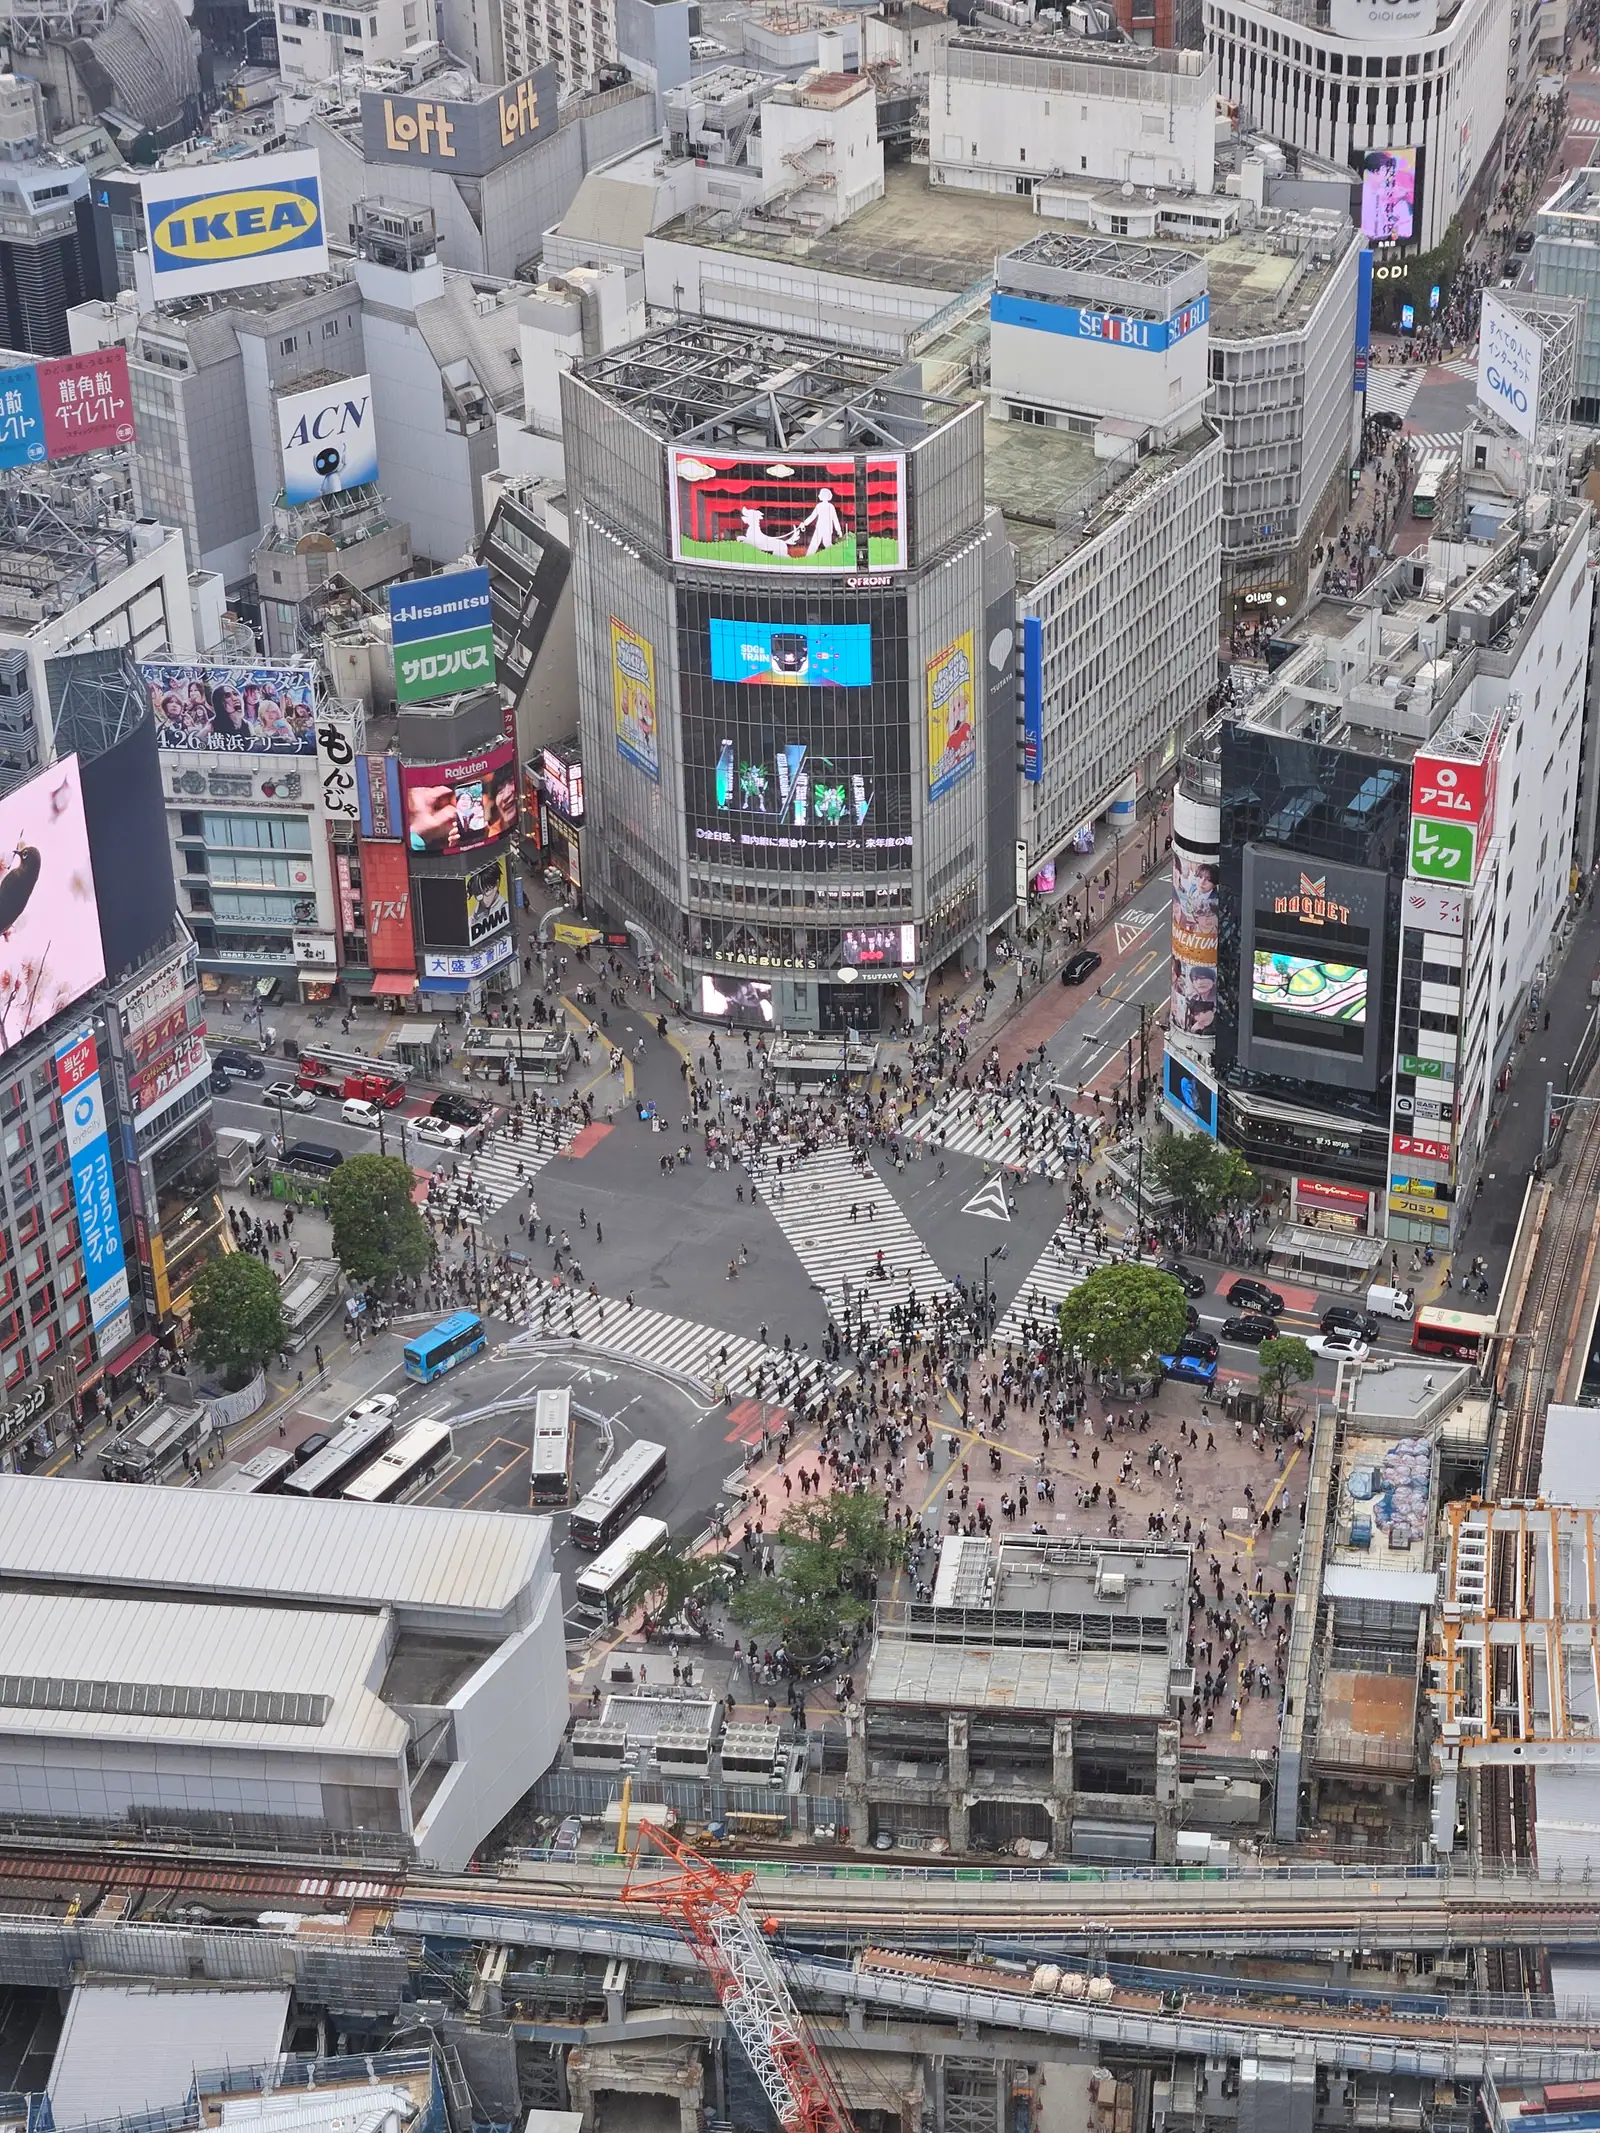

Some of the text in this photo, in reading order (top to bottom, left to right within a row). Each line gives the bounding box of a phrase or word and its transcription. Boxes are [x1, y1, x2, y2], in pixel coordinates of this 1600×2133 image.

[1395, 10, 1421, 20] GROUP
[168, 201, 308, 247] IKEA
[1371, 264, 1408, 280] ODI
[1079, 312, 1149, 347] SEIBU
[1168, 301, 1206, 343] SEIBU
[1489, 320, 1532, 365] すべての人に
[1488, 341, 1530, 384] インターネット
[59, 370, 113, 404] 龍角散
[1486, 366, 1528, 413] GMO
[0, 389, 24, 417] 散
[55, 397, 125, 429] ダイレクト
[284, 396, 370, 450] ACN
[392, 594, 490, 622] Hisamitsu
[1245, 592, 1272, 603] Olive
[401, 645, 490, 684] サロンパス
[740, 652, 770, 662] TRAIN
[220, 668, 312, 691] スターダム
[990, 672, 1013, 696] TSUTAYA
[156, 730, 200, 750] 4.26
[206, 731, 309, 753] 横浜アリーナ
[1025, 729, 1037, 774] SEIBU
[318, 723, 358, 818] もんじゃ
[444, 760, 488, 779] Rakuten
[1419, 786, 1472, 812] アコム
[841, 890, 865, 898] based
[876, 888, 899, 896] CAFE
[370, 893, 409, 934] クスリ
[471, 906, 508, 942] DMM
[1274, 896, 1350, 925] MAGNET
[432, 940, 508, 973] 大盛堂書店
[715, 951, 816, 969] STARBUCKS
[862, 972, 899, 981] TSUTAYA
[63, 1046, 90, 1073] 当ビル
[174, 1034, 199, 1060] ガスト
[71, 1066, 86, 1083] 5F
[156, 1060, 188, 1096] ガスト
[1405, 1058, 1440, 1073] レイク
[72, 1116, 101, 1146] eyecity
[1399, 1139, 1437, 1156] アコム
[77, 1163, 104, 1264] アイシティ
[94, 1153, 118, 1256] コンタクトの
[1400, 1201, 1436, 1215] プロミス
[93, 1276, 125, 1305] Contact Lens
